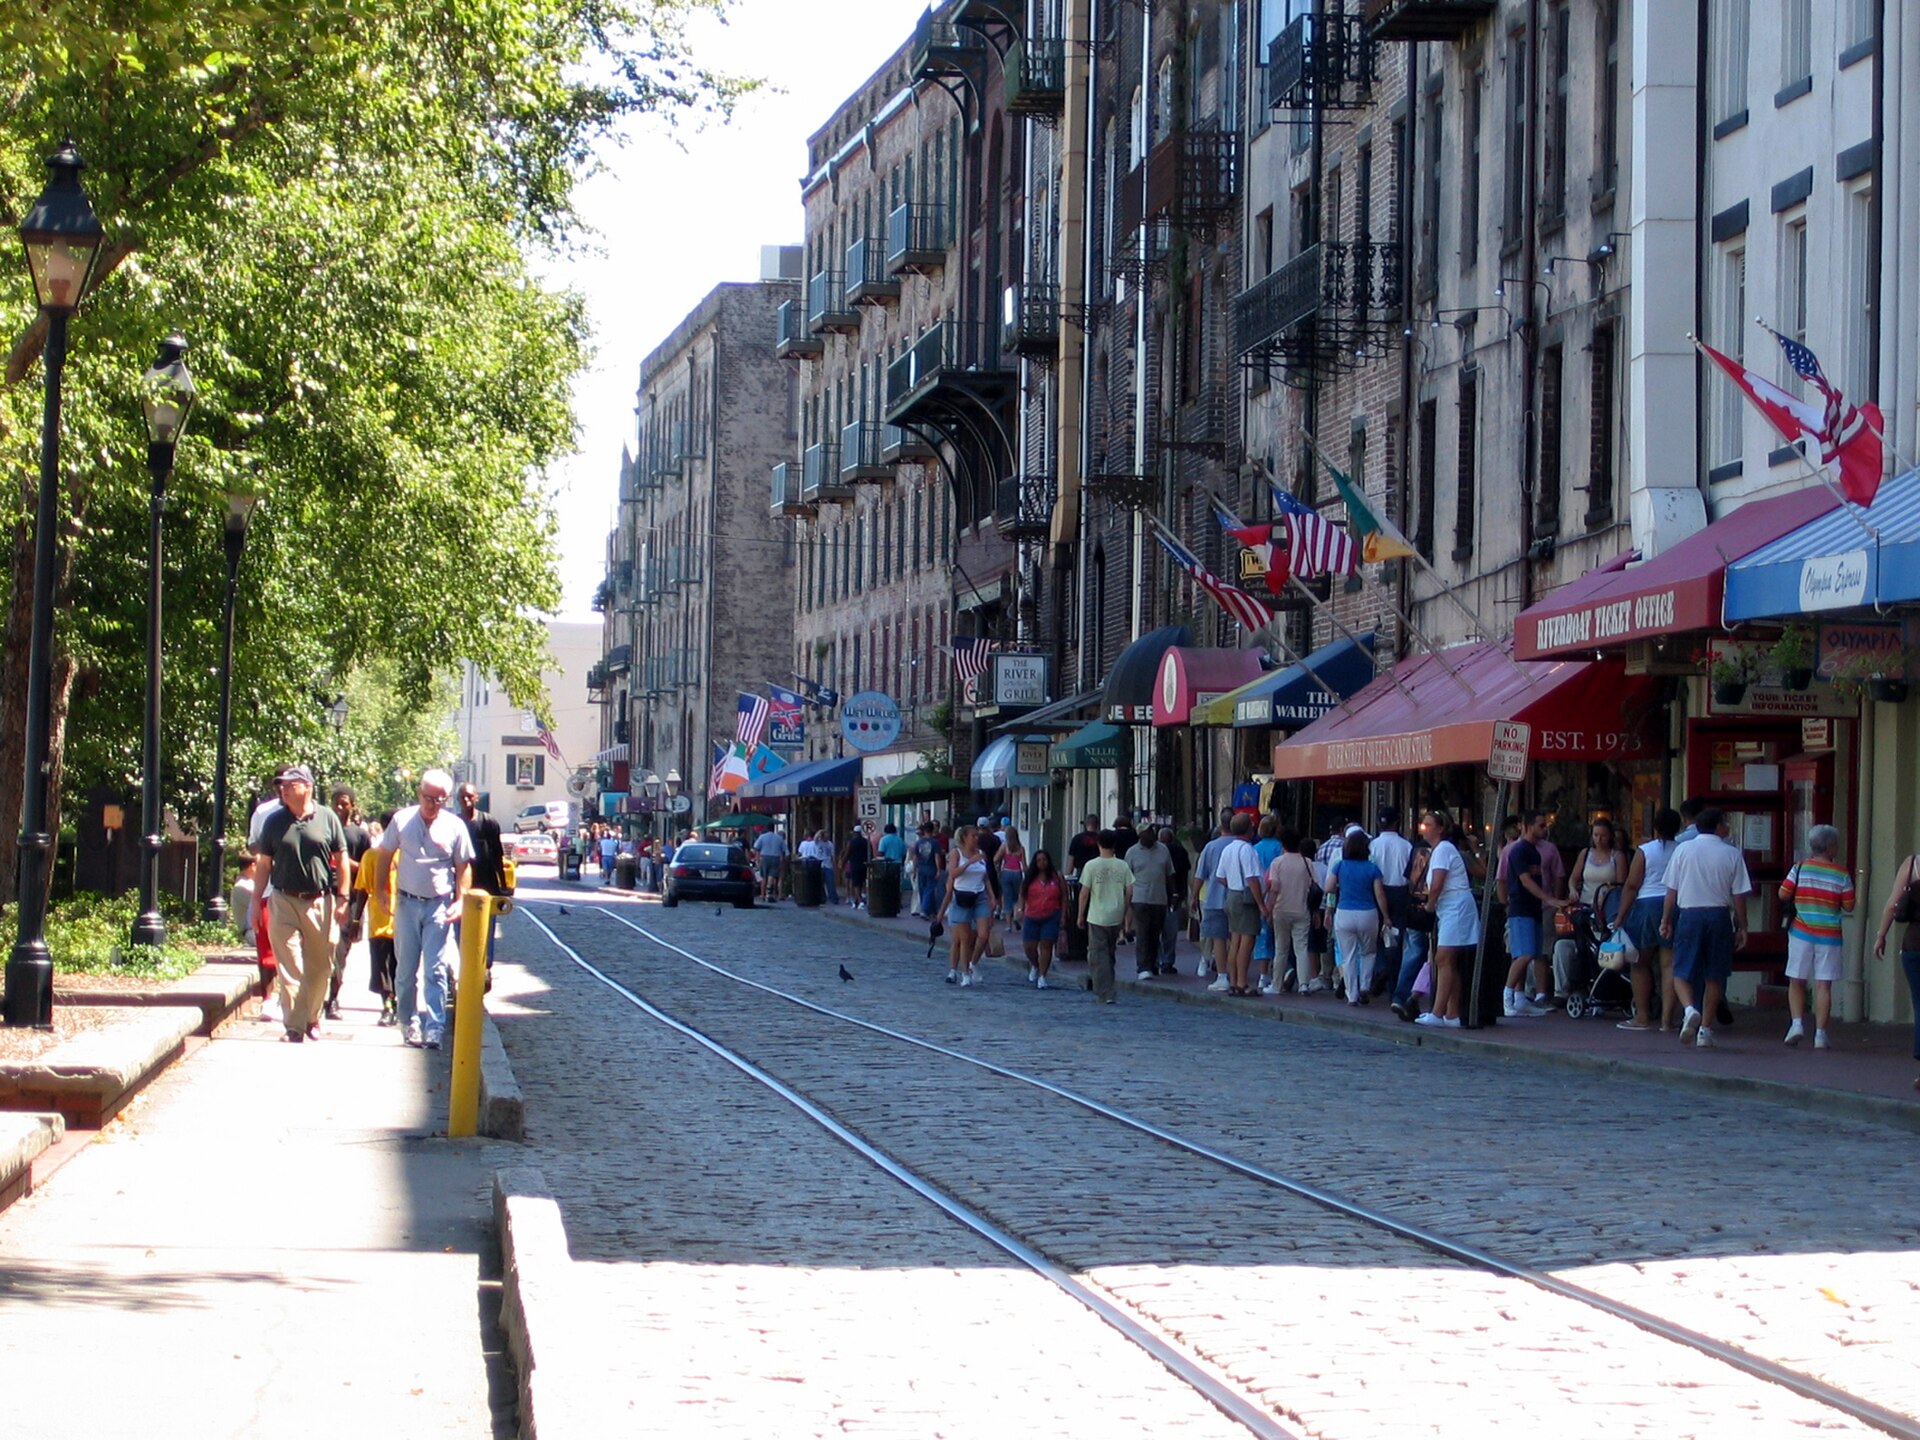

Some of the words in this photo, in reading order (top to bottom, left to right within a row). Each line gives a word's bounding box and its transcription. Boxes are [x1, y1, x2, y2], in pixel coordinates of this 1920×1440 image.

[1537, 609, 1591, 650] RIVERBOAT
[1595, 600, 1631, 638] TICKET
[1635, 590, 1674, 629] OFFICE
[1828, 631, 1900, 650] OLYMPIA
[1012, 659, 1027, 667] THE
[1004, 669, 1036, 679] RIVER
[1004, 689, 1037, 700] GRILL
[1783, 694, 1818, 702] TICKET
[1503, 727, 1518, 739] NO
[1494, 739, 1525, 753] PARKING
[1541, 731, 1585, 750] EST.
[1595, 733, 1641, 751] 1973
[1508, 756, 1522, 764] SIDE
[860, 803, 877, 816] 15
